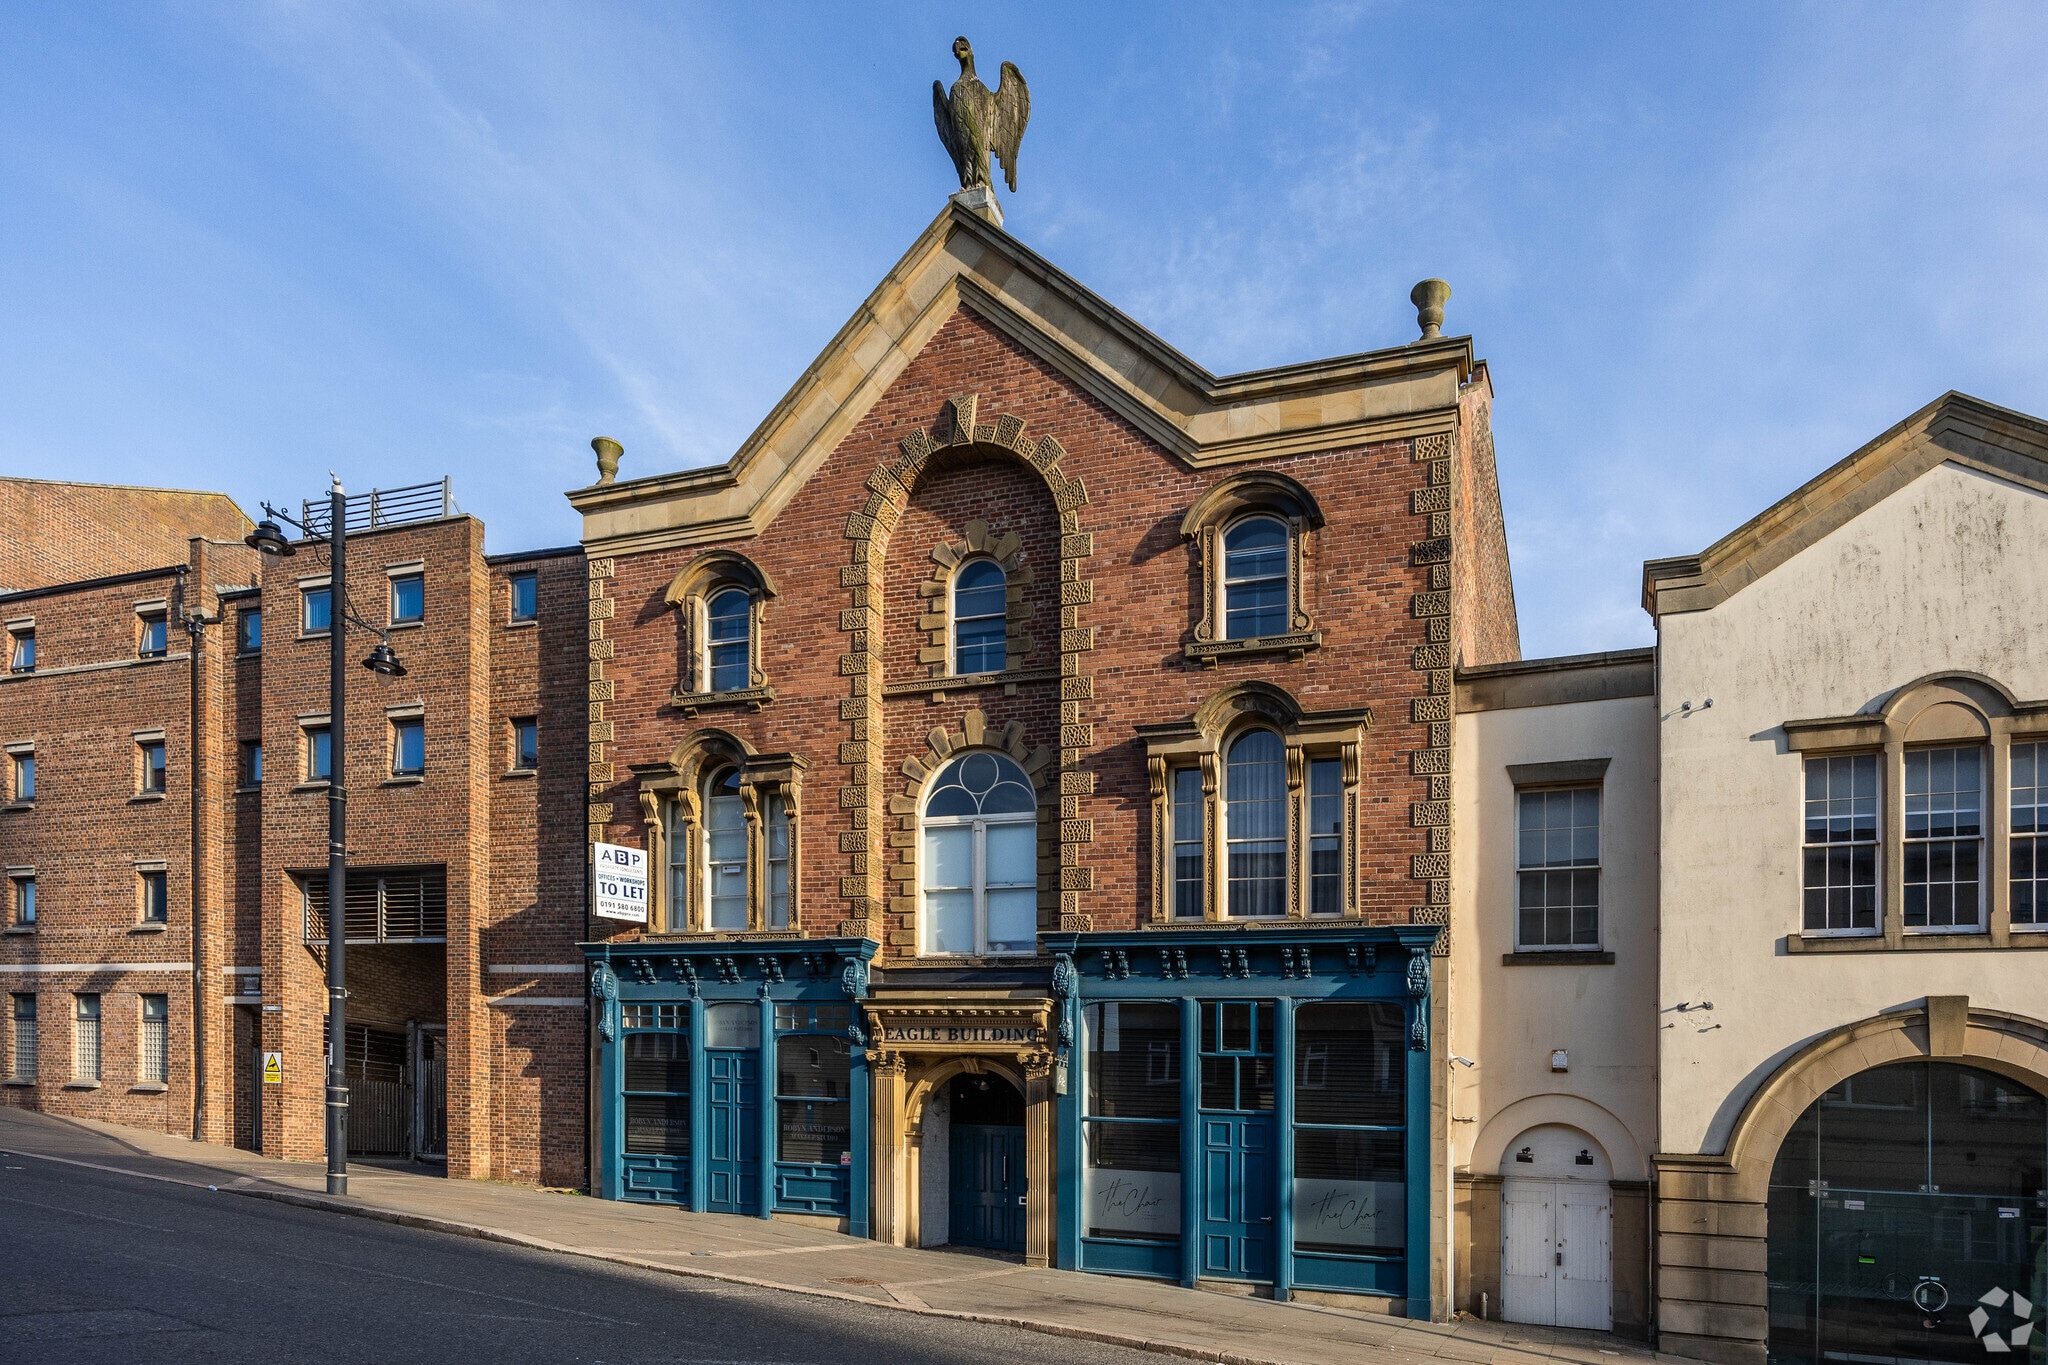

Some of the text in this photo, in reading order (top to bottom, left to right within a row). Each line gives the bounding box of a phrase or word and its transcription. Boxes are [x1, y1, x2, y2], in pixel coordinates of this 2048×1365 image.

[598, 873, 646, 886] OFFICES WORKSHOPS
[600, 882, 644, 899] TO LET
[630, 905, 645, 913] 6800
[885, 1027, 1038, 1042] EAGLE BUILDING
[808, 1125, 846, 1133] ANDERSON
